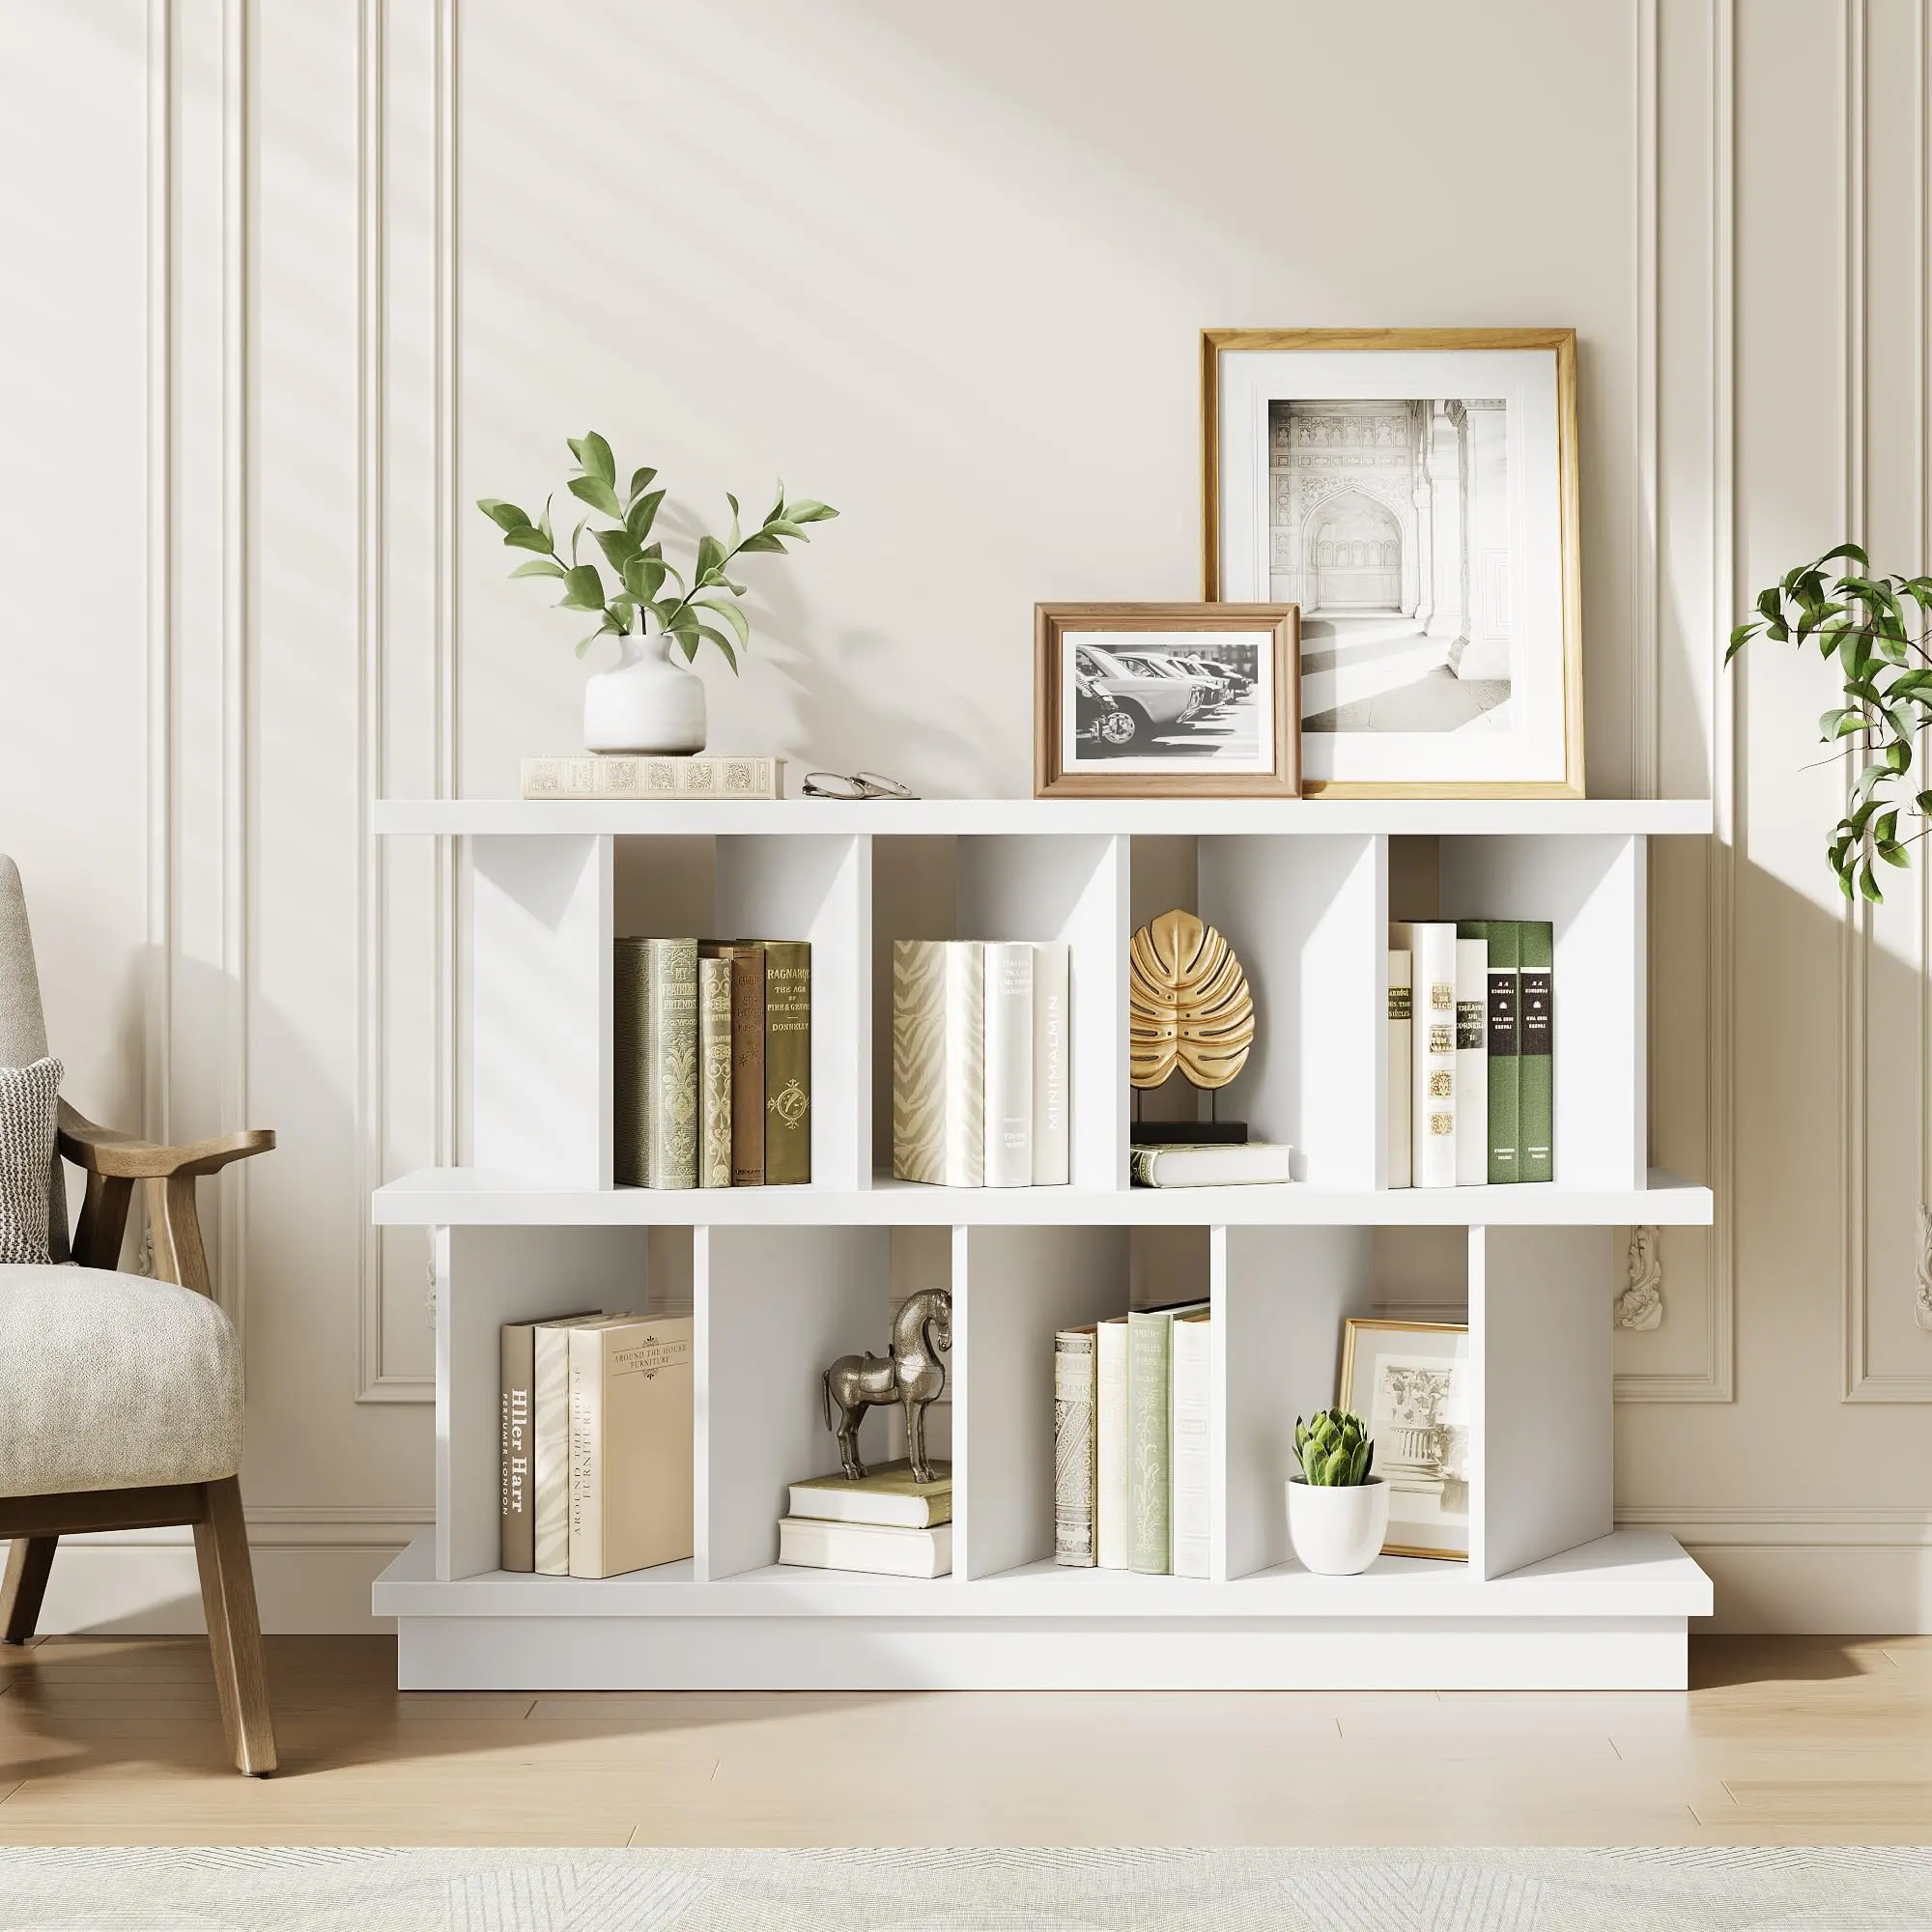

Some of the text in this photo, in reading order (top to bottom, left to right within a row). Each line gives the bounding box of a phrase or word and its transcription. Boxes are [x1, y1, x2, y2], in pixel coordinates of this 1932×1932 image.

[675, 967, 688, 980] MY
[774, 985, 791, 994] THE
[1433, 1002, 1453, 1010] NICO
[772, 1022, 810, 1032] DONNELLY
[1047, 995, 1059, 1129] MINIMALMIN
[613, 1344, 687, 1363] AROUND THE HOUSE
[630, 1355, 670, 1369] FURNITURE
[582, 1405, 591, 1499] FURNITURE
[512, 1456, 527, 1513] Harr
